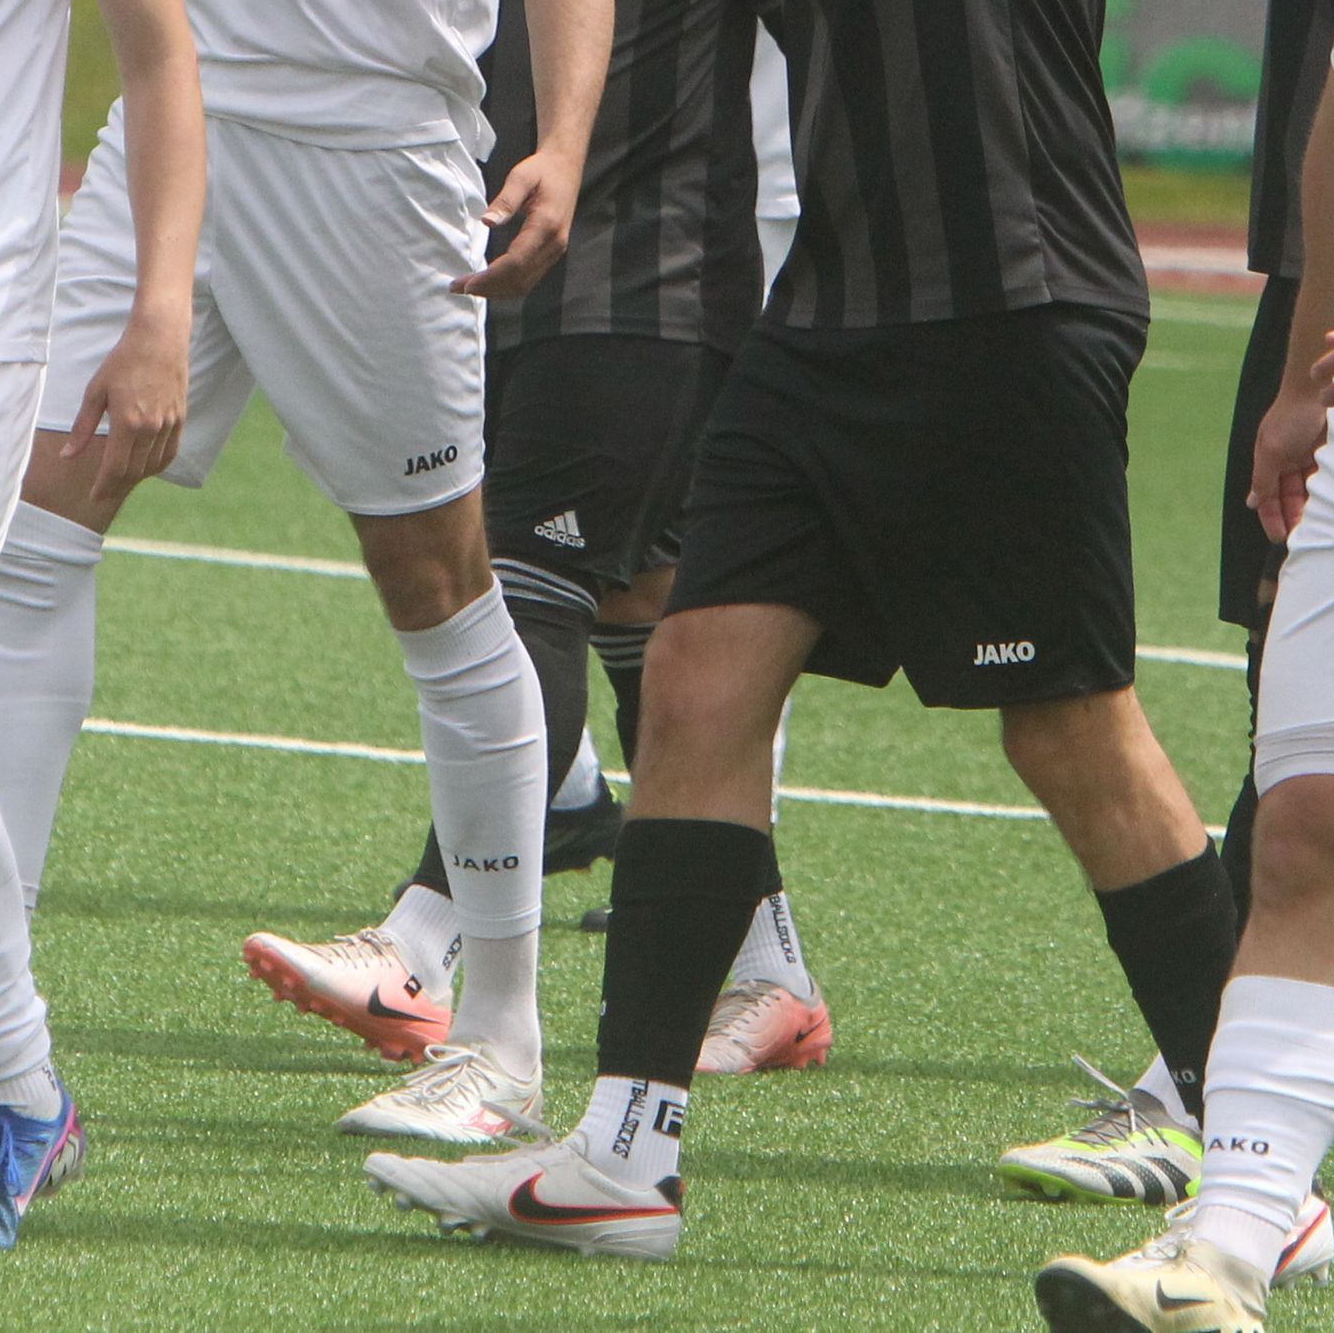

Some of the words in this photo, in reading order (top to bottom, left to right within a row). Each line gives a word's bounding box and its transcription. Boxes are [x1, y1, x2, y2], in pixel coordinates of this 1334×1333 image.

[404, 445, 458, 476] JAKO
[533, 525, 585, 549] adidas
[973, 640, 1036, 666] JAKO
[452, 854, 520, 873] JAKO
[1207, 1137, 1270, 1156] AKO
